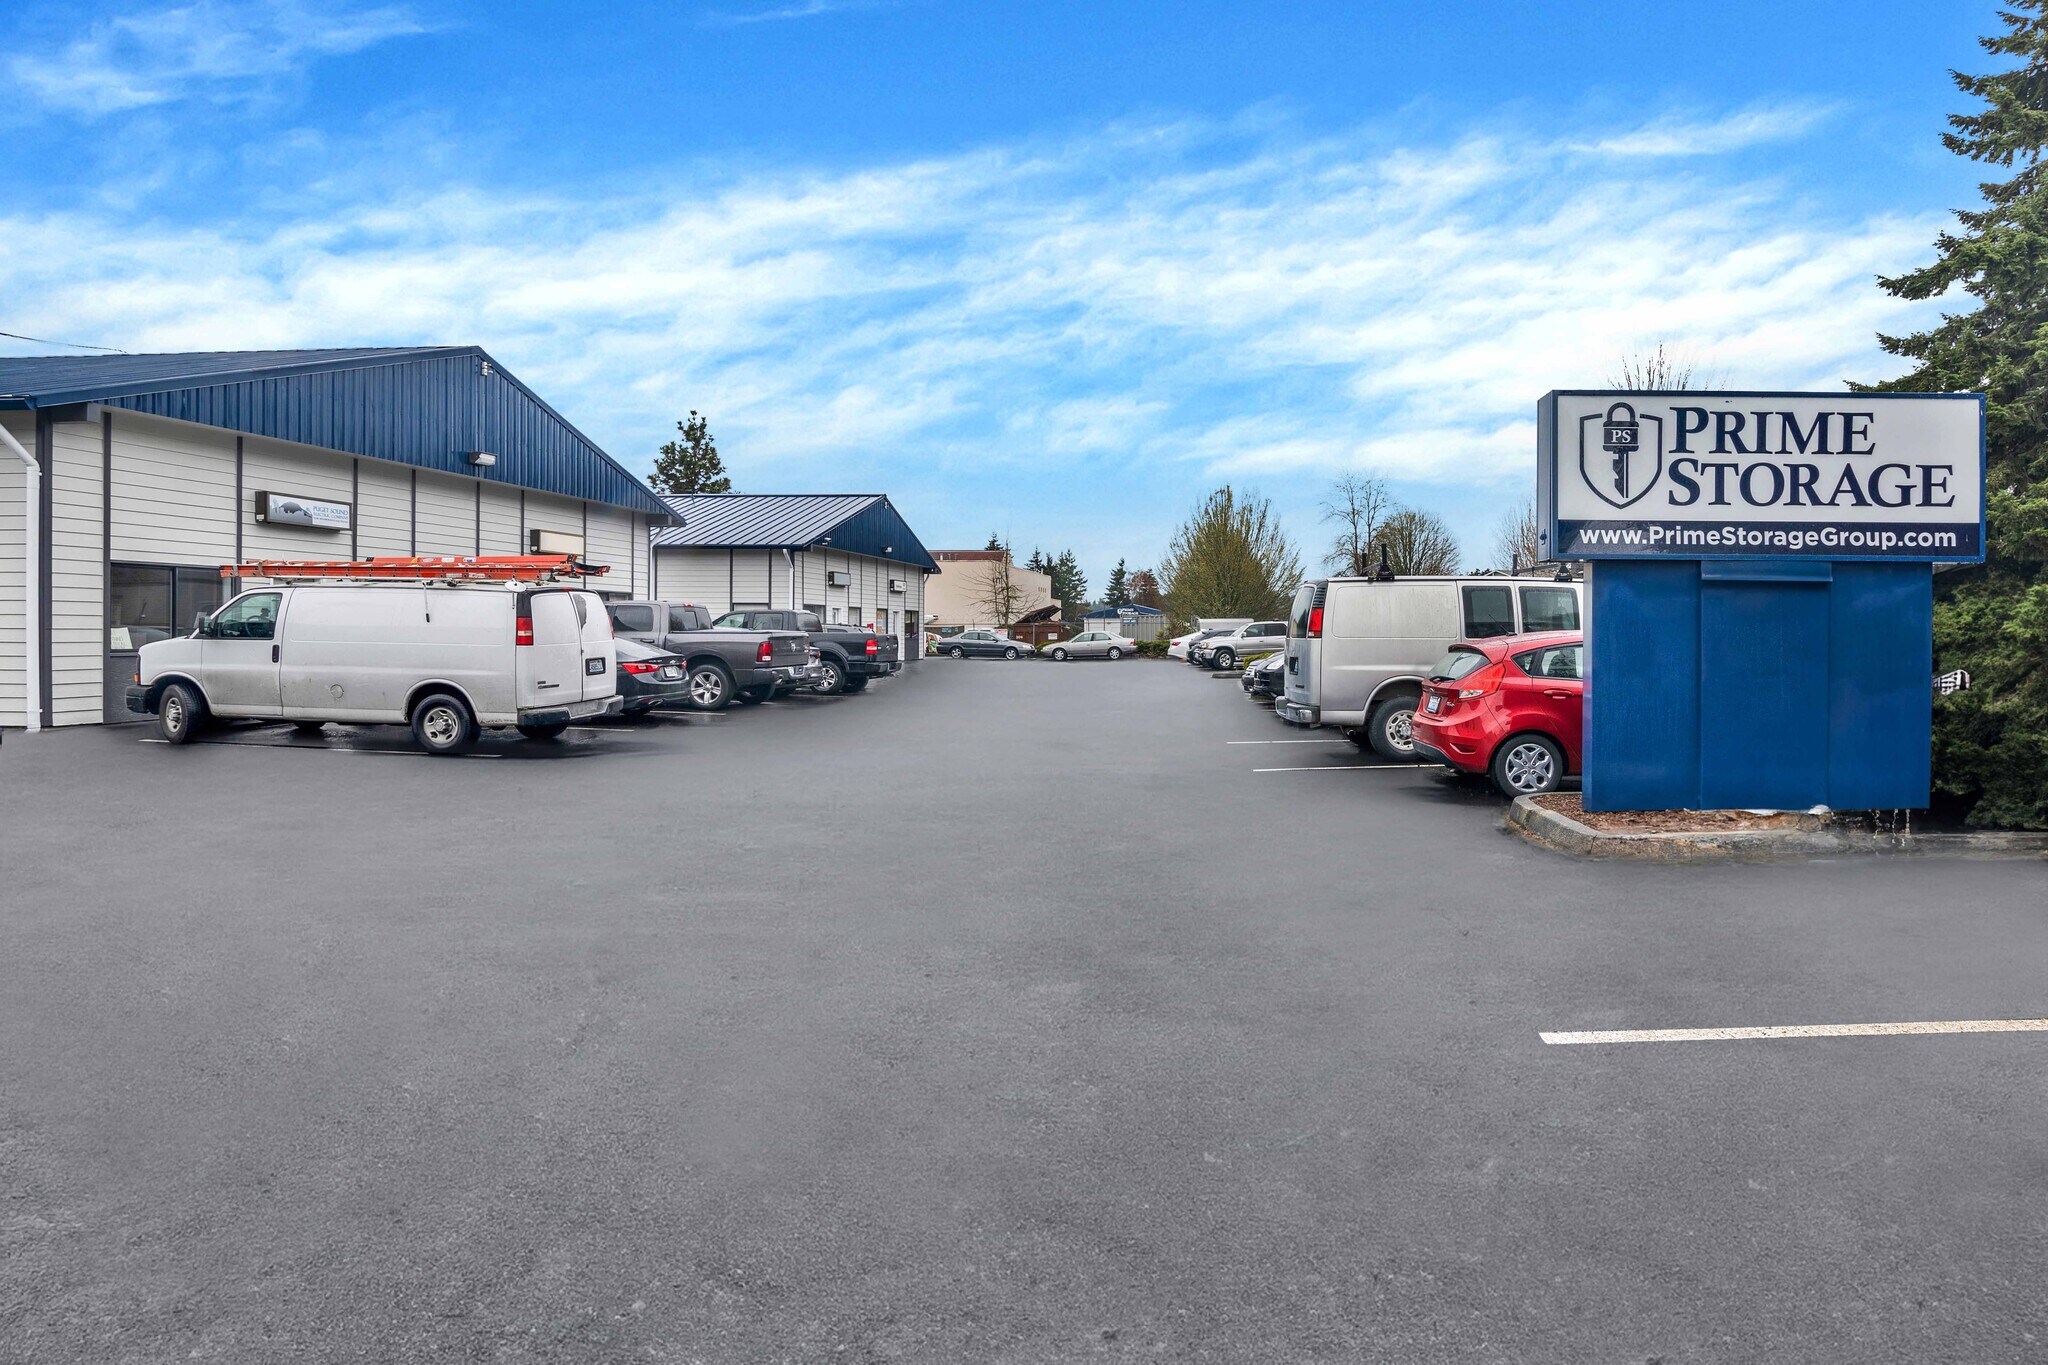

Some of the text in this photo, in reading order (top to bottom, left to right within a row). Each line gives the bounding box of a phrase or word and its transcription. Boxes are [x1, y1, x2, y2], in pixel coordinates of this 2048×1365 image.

[1611, 429, 1631, 444] PS
[1668, 406, 1877, 455] PRIME
[1668, 457, 1956, 508] STORAGE
[1579, 526, 1957, 549] www.PrimeStorageGroup.com
